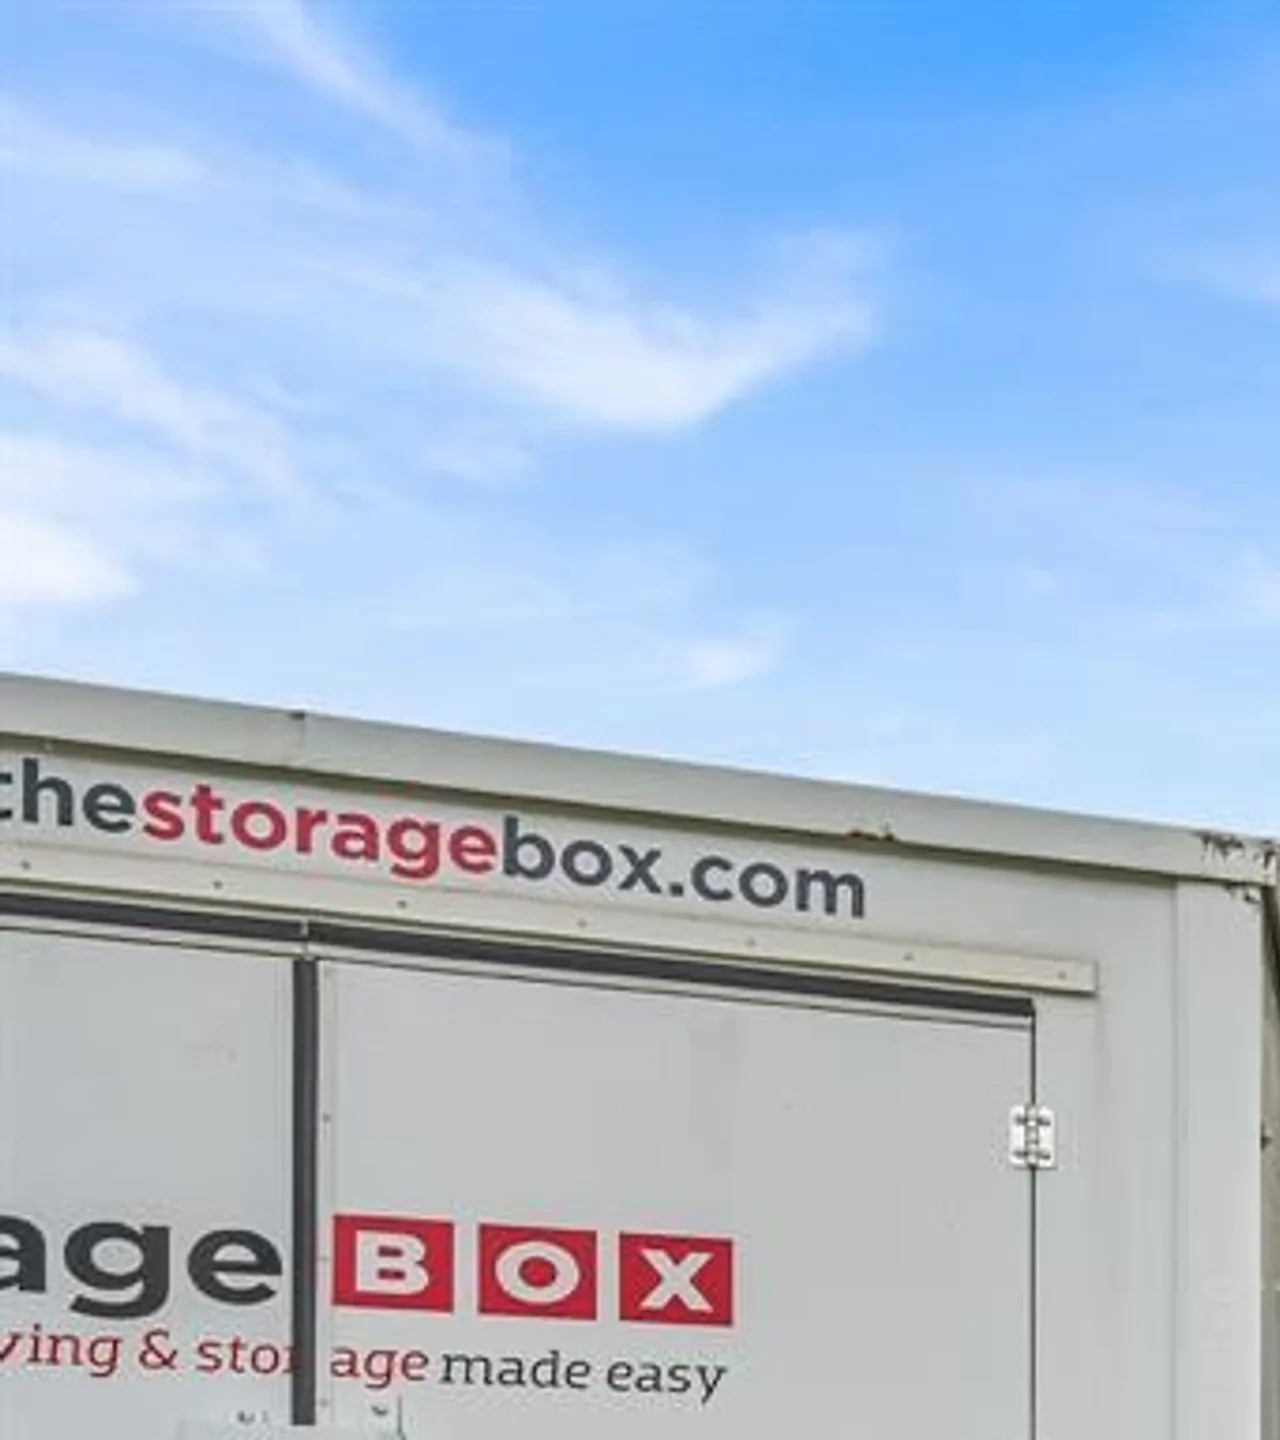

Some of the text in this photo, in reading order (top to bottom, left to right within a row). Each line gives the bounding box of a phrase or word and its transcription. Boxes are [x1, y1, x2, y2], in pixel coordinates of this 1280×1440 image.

[354, 1229, 715, 1314] BOX
[139, 1328, 178, 1370] &
[441, 1349, 591, 1389] made
[606, 1359, 728, 1404] easy
